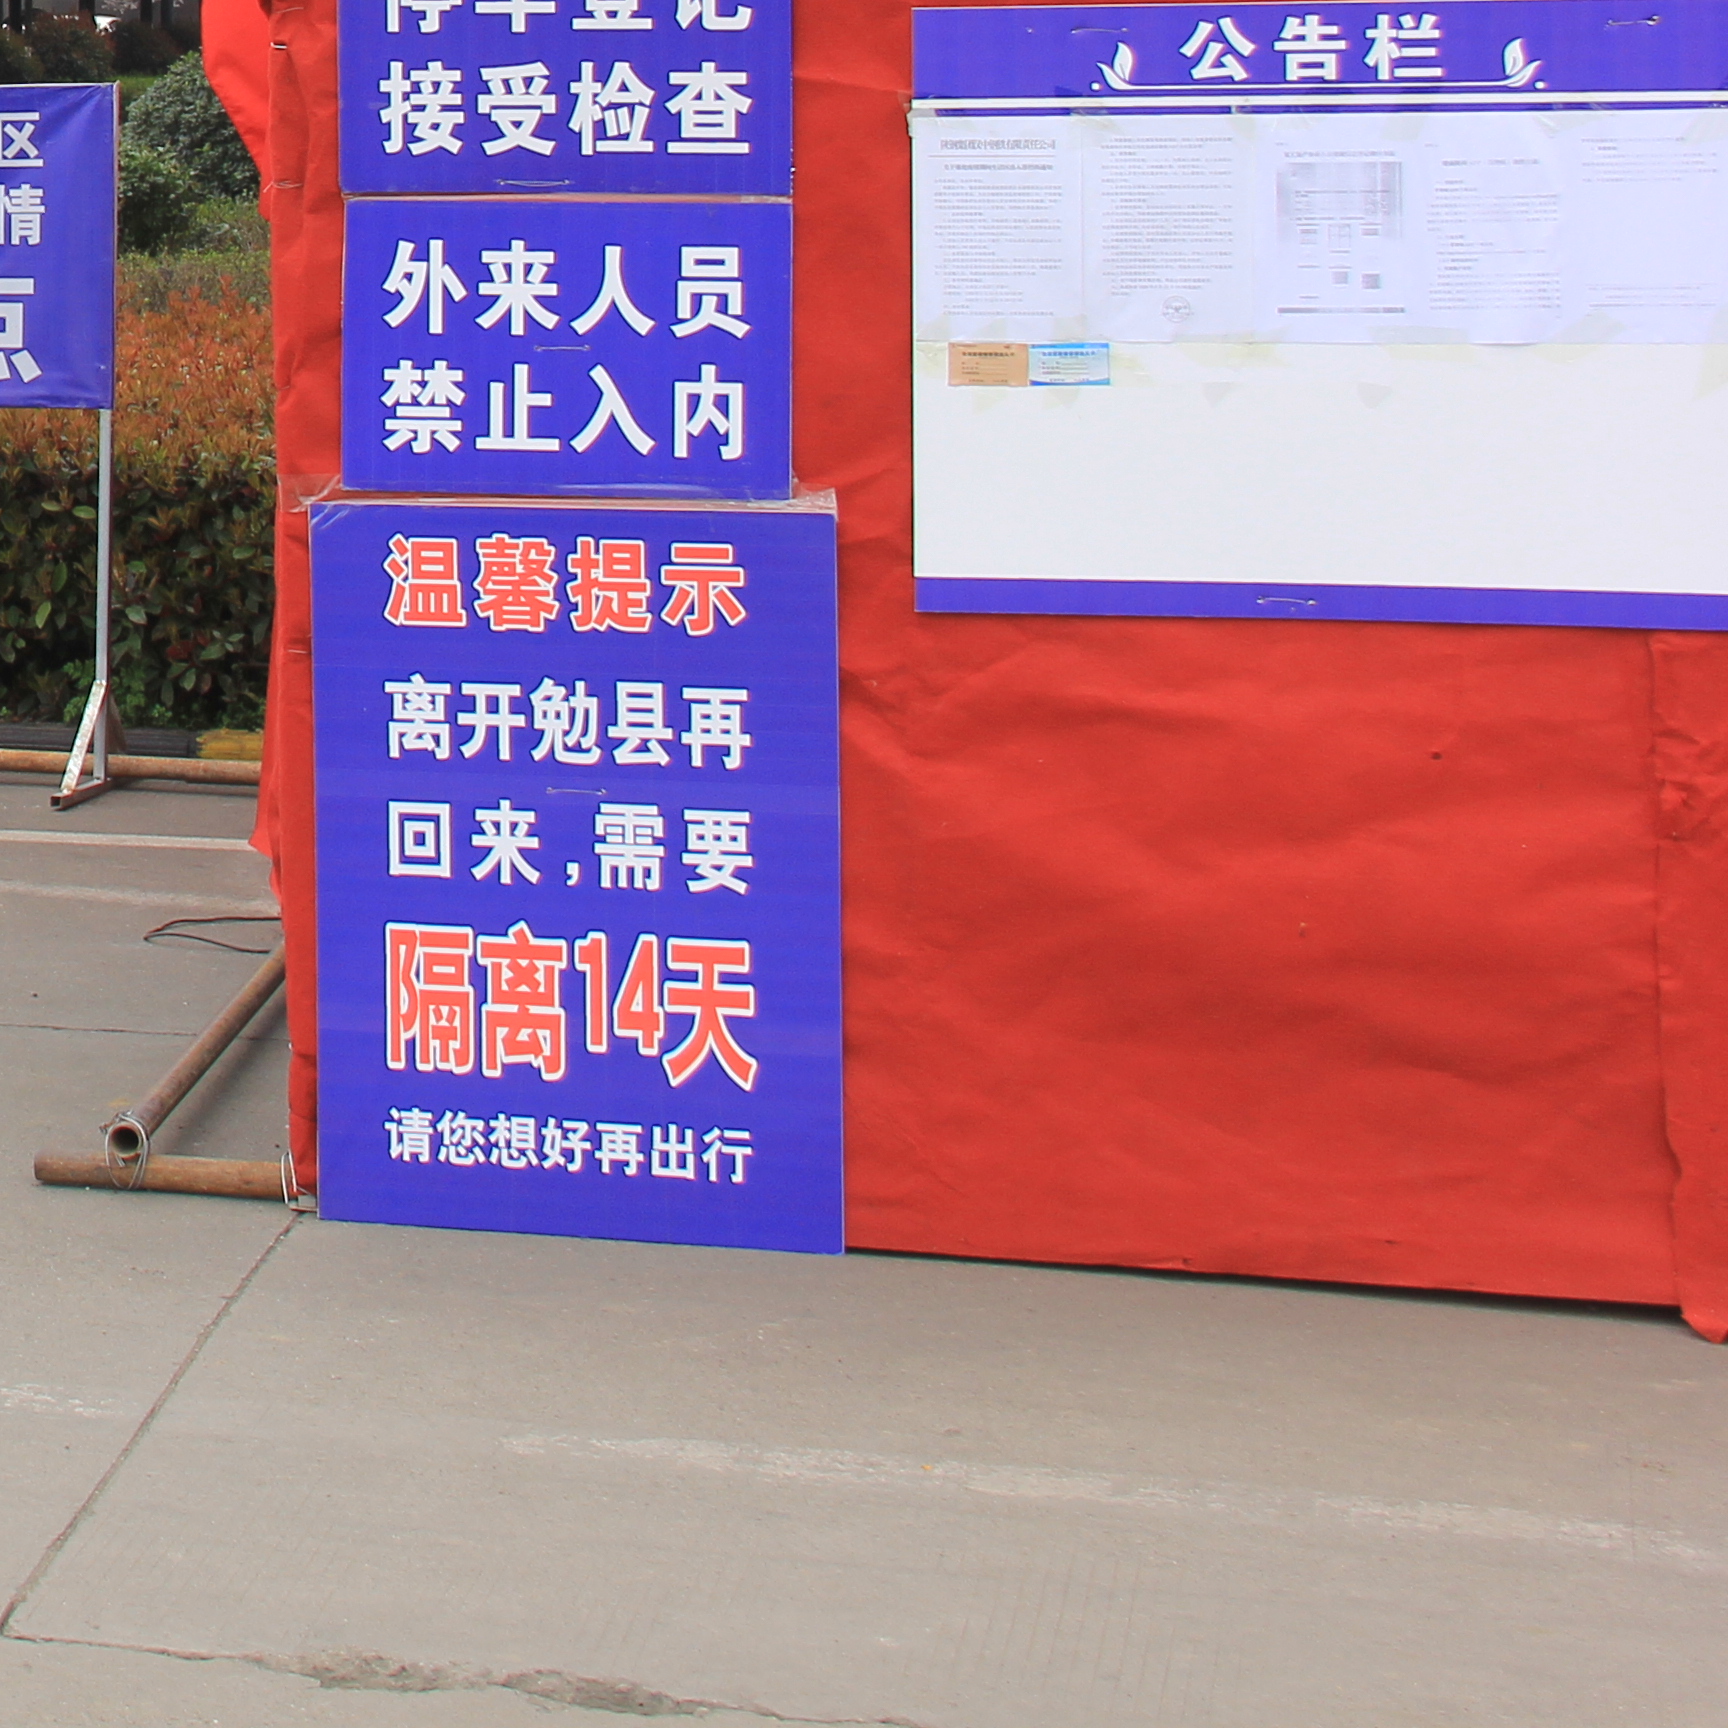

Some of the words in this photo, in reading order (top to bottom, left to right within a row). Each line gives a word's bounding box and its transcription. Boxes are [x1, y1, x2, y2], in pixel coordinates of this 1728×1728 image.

[1179, 13, 1444, 83] 公告栏
[379, 60, 753, 156] 接受检查
[382, 239, 751, 339] 外来人员
[379, 358, 745, 461] 禁止入内
[382, 532, 747, 637] 温馨提示
[384, 673, 752, 771] 离开勉县再
[388, 799, 753, 895] 回来，需要
[384, 920, 758, 1092] 隔离14天
[384, 1107, 753, 1184] 请您想好再出行
